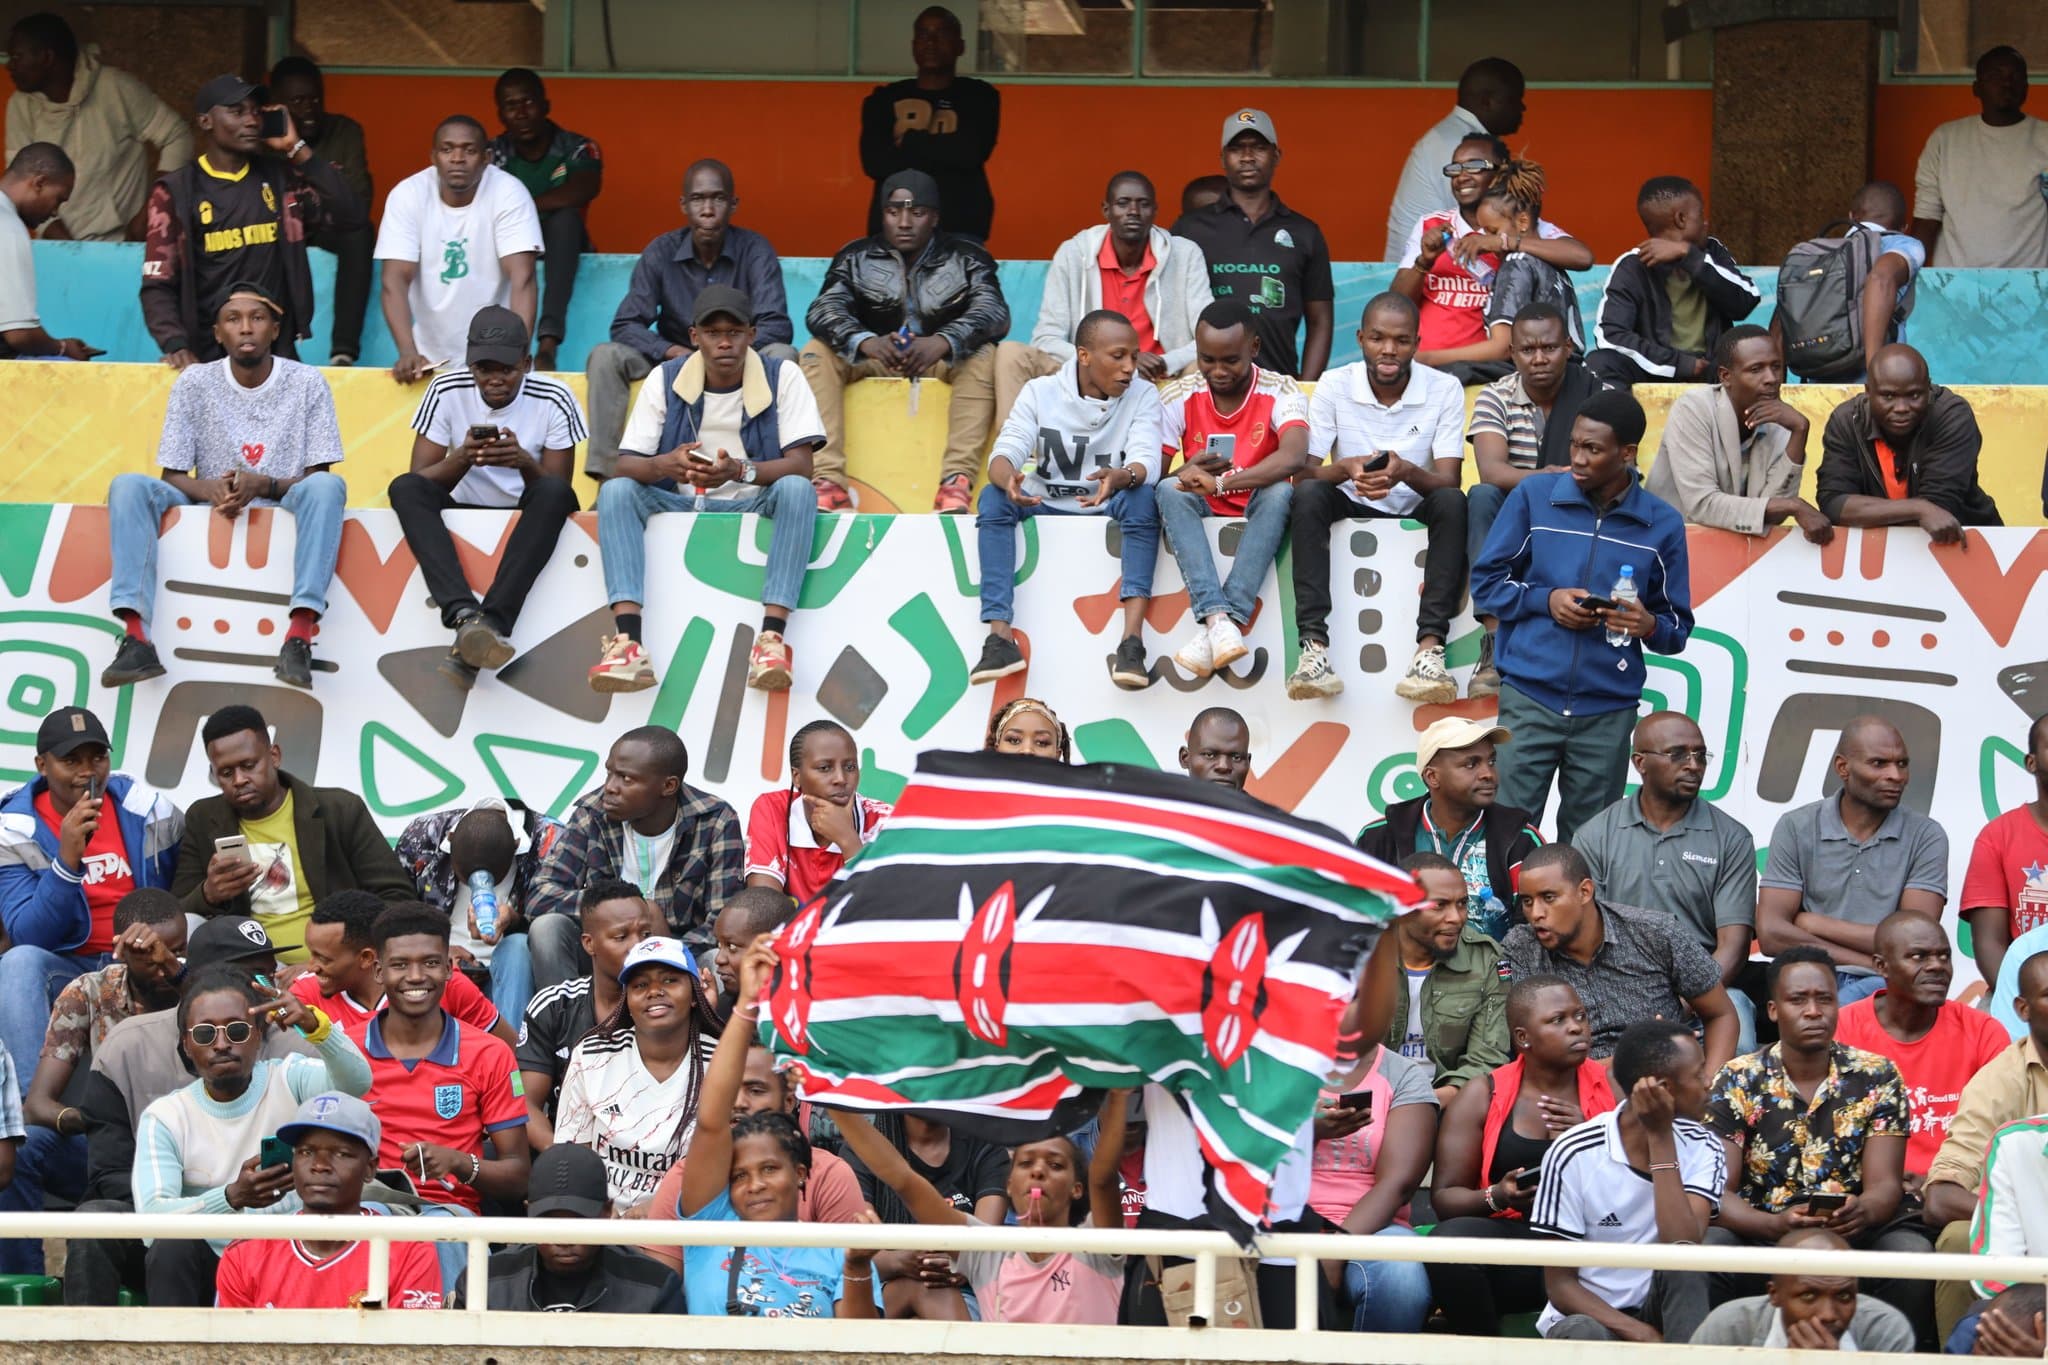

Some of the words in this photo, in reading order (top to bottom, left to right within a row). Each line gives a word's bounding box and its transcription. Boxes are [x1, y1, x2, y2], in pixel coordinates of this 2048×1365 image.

[1212, 263, 1281, 274] KOGALO
[1682, 850, 1718, 865] Siemens
[1927, 1094, 1948, 1103] Cloud
